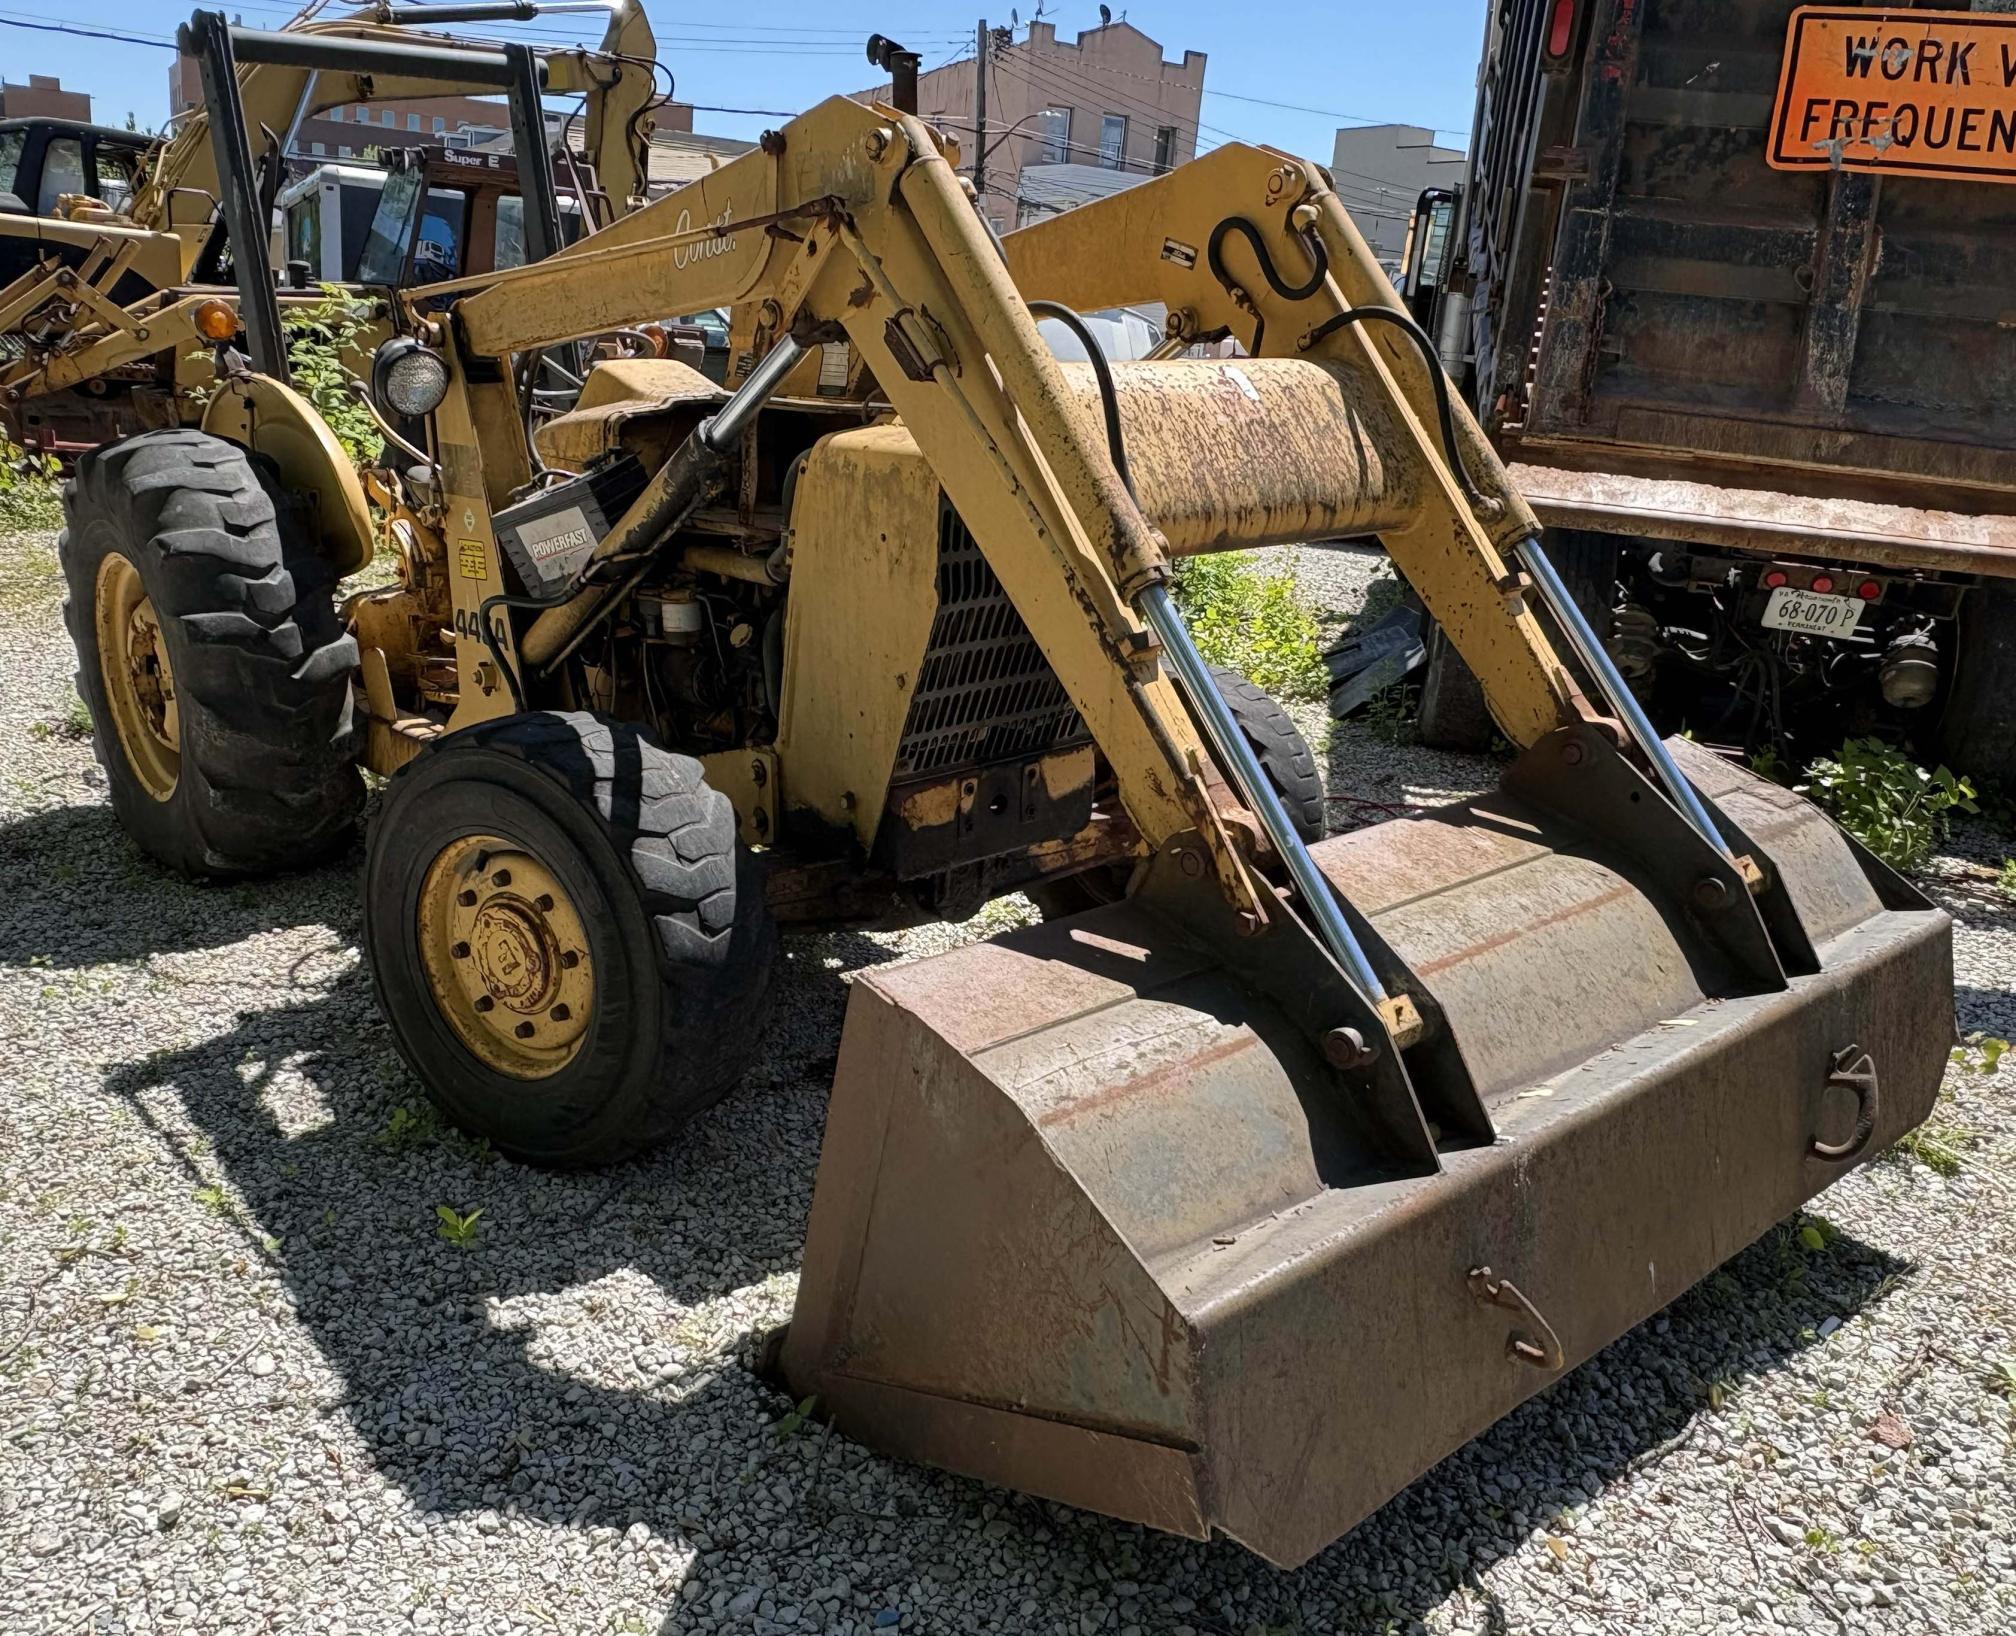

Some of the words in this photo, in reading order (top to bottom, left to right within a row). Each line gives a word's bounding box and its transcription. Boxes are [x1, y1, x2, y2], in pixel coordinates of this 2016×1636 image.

[1845, 36, 1977, 86] WORK
[1800, 98, 2016, 153] FREQUEN
[444, 149, 482, 167] Super
[488, 154, 500, 168] E
[531, 528, 588, 558] POWERFAST
[456, 608, 509, 651] 44A
[1779, 600, 1838, 625] 68-070
[1840, 609, 1854, 627] P
